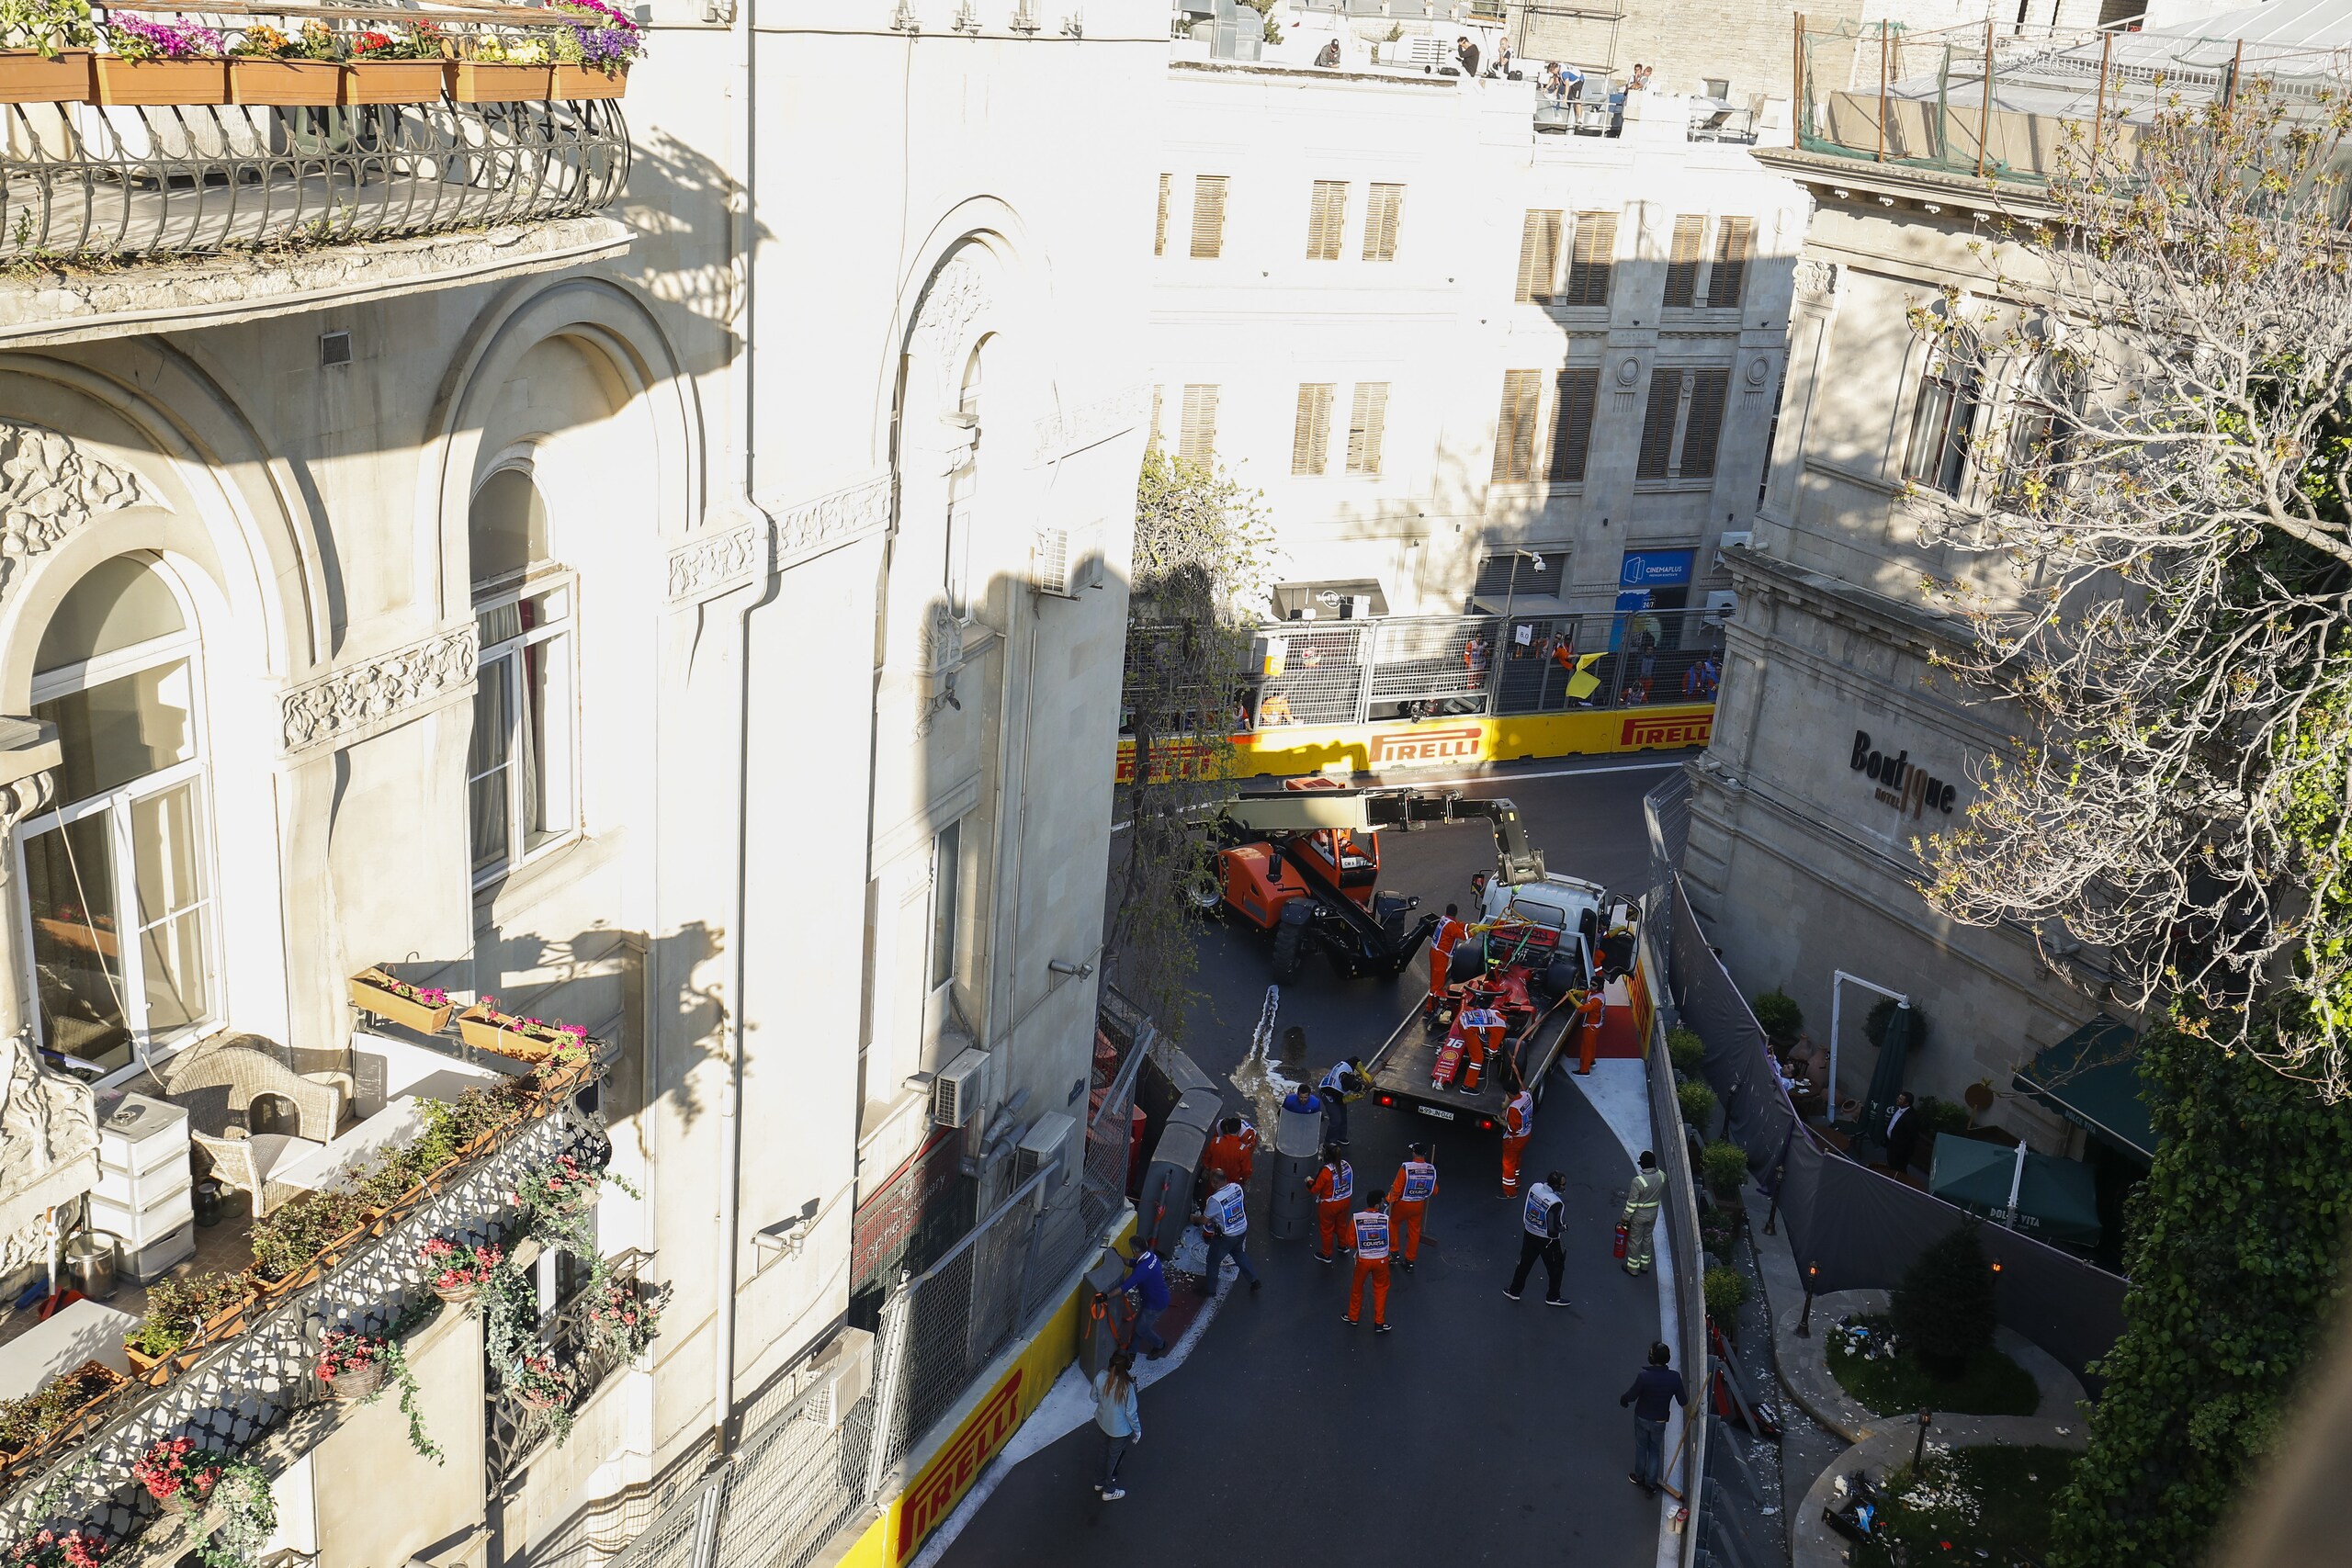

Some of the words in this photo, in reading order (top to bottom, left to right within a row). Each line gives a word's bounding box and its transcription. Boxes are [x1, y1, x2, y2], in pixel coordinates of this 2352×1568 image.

[1369, 728, 1482, 762] PIRELLI
[1621, 715, 1713, 745] PIRELL
[1850, 729, 1956, 820] Boutique
[1446, 1037, 1464, 1049] 16
[2064, 1110, 2084, 1126] DOLCE
[1990, 1207, 2018, 1222] DOLE
[2020, 1214, 2040, 1228] VITA
[897, 1368, 1023, 1563] PIRELLI
